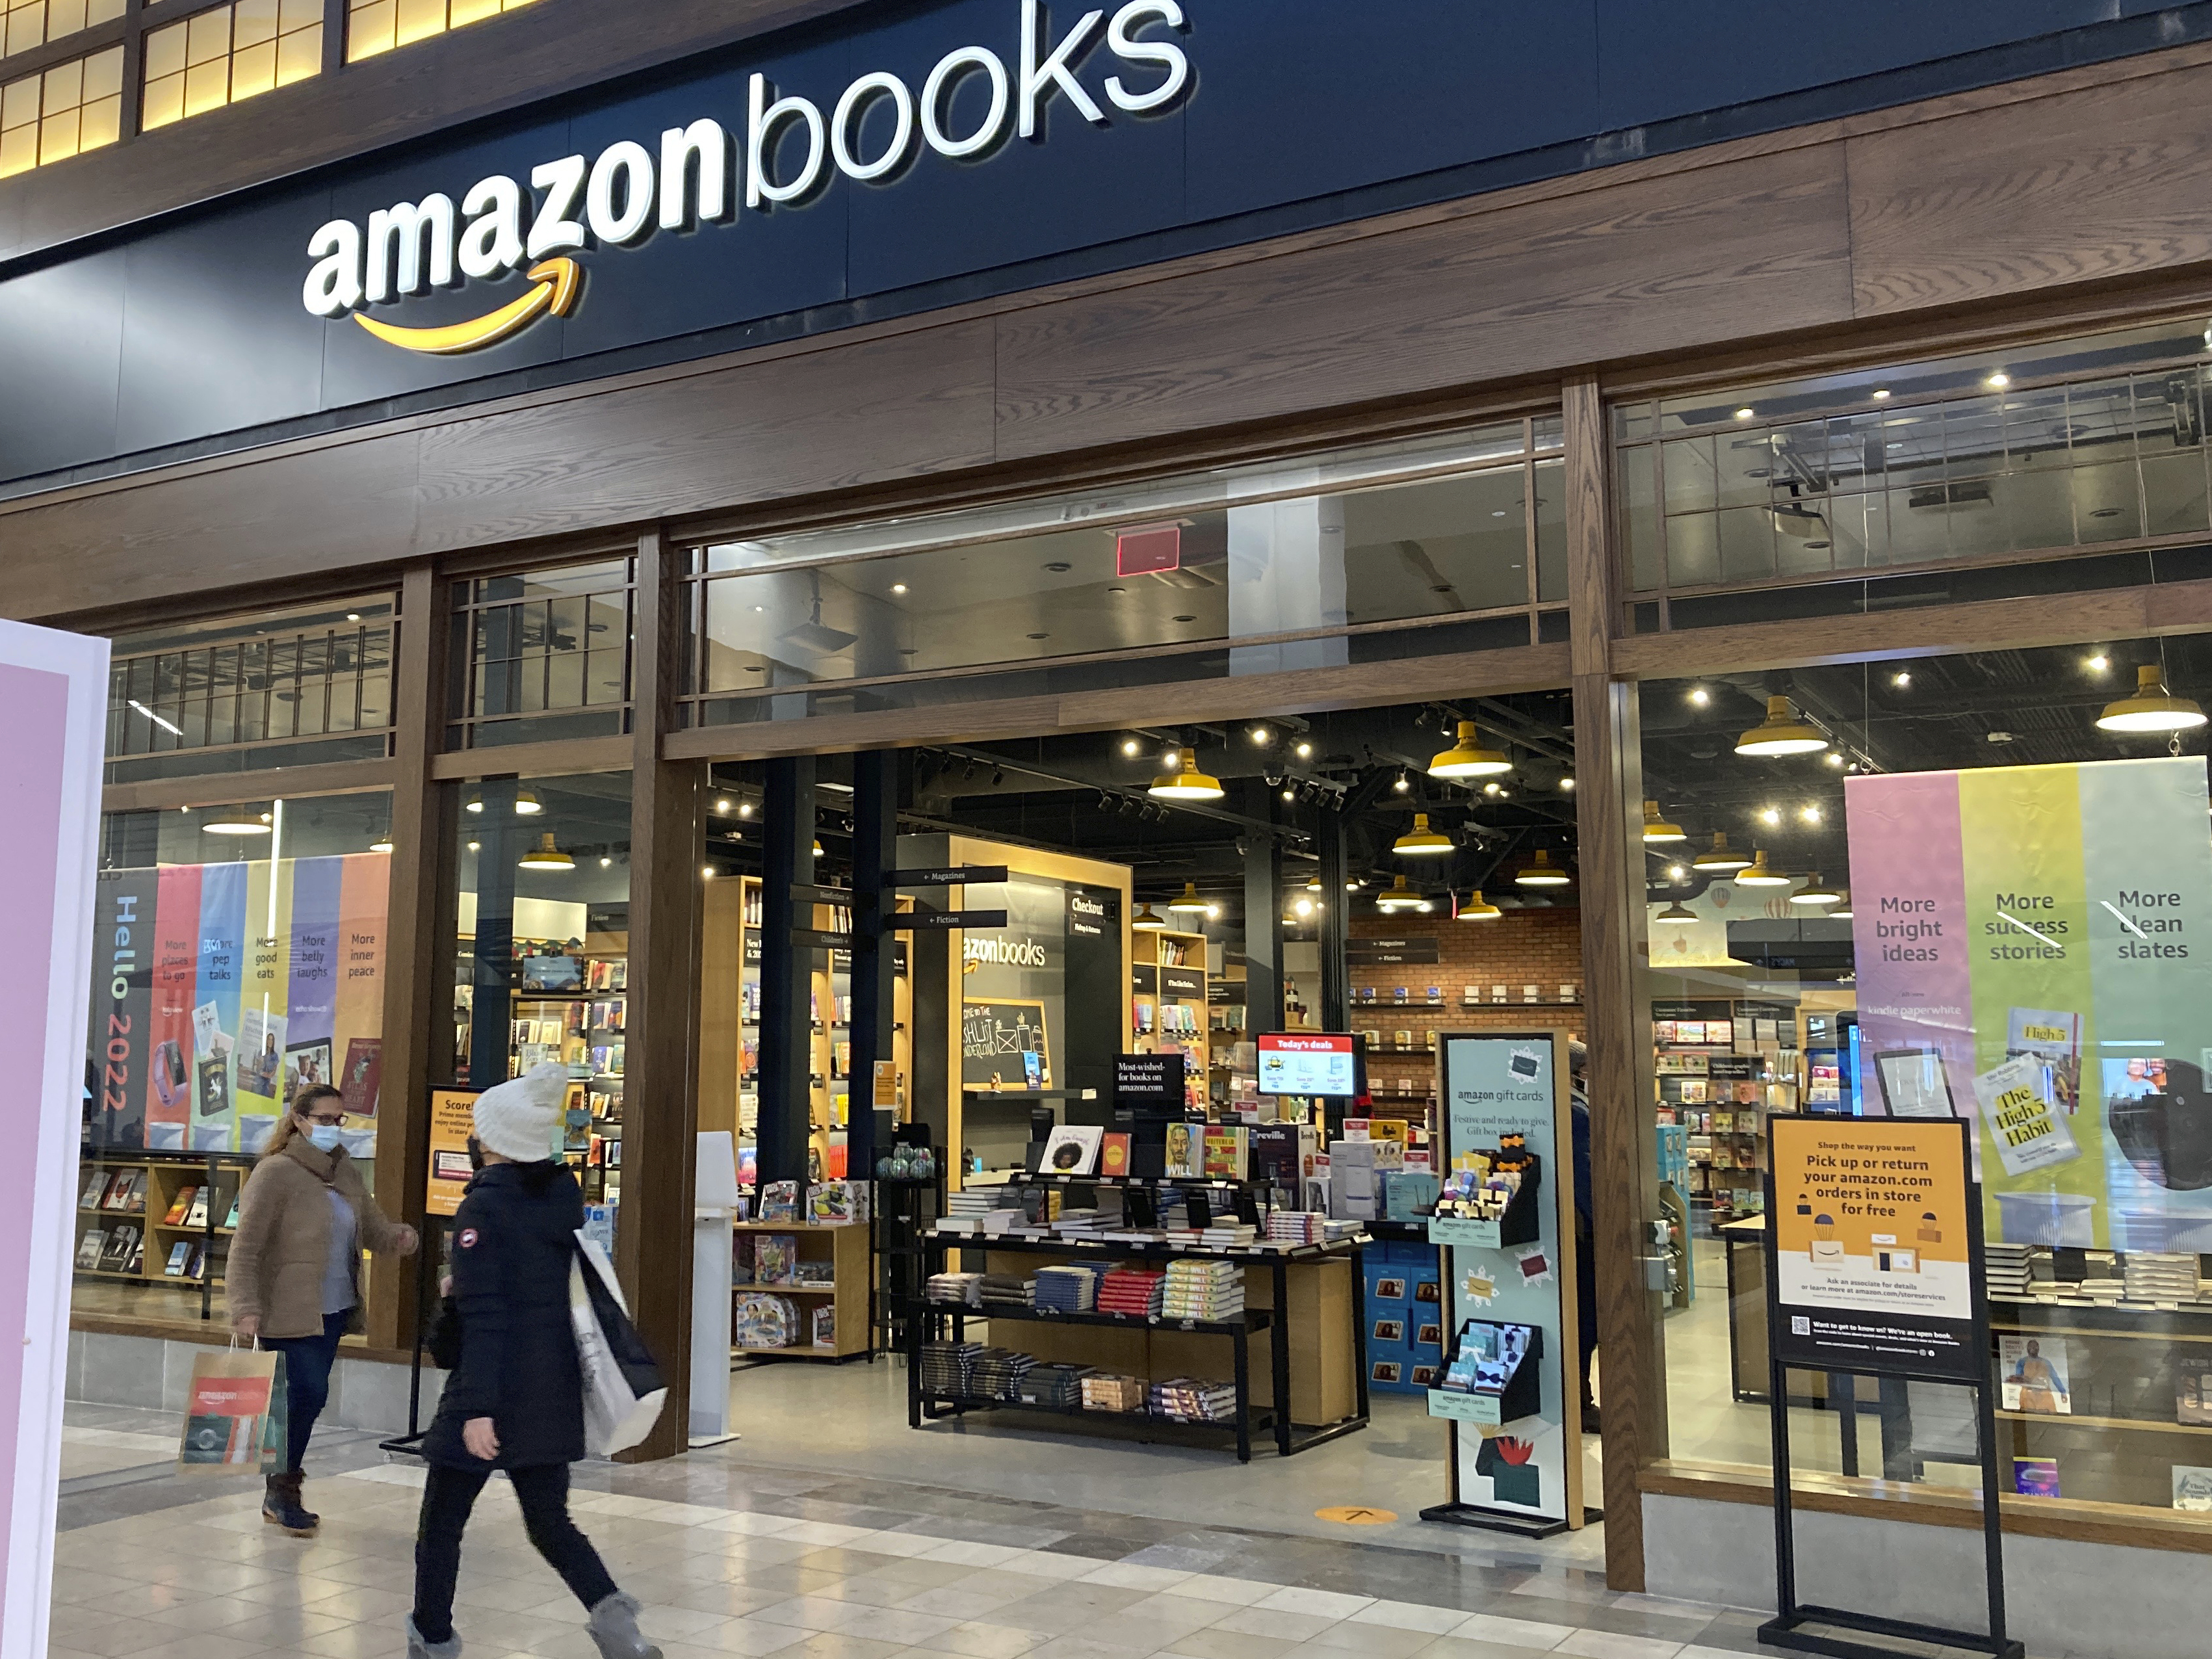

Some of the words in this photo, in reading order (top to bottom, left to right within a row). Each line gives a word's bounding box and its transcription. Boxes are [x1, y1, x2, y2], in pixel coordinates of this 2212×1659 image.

[931, 872, 965, 881] Magazines
[1880, 896, 1936, 913] More
[1996, 893, 2055, 910] More
[2119, 890, 2181, 908] More
[1072, 897, 1104, 915] Checkout
[1876, 919, 1944, 941] bright
[1985, 920, 2068, 935] success
[2120, 915, 2183, 933] clean
[165, 940, 187, 950] More
[302, 935, 325, 946] More
[352, 934, 375, 944] More
[111, 896, 137, 1000] Hello
[1882, 945, 1939, 962] ideas
[1990, 941, 2066, 960] stories
[2118, 941, 2189, 959] slates
[213, 954, 230, 965] pep
[255, 952, 278, 966] good
[301, 950, 324, 964] belly
[350, 949, 375, 961] inner
[163, 970, 172, 980] to
[174, 971, 185, 982] go
[209, 969, 231, 980] talks
[257, 969, 275, 978] eats
[297, 967, 328, 980] laughs
[348, 967, 375, 980] peace
[1867, 1006, 1899, 1015] kindle
[1900, 1006, 1962, 1017] paperwhite
[2025, 1026, 2053, 1041] High
[2056, 1030, 2066, 1041] 5
[1277, 1040, 1308, 1050] Today's
[1310, 1040, 1333, 1049] deals
[103, 1013, 131, 1112] 2022
[1118, 1062, 1165, 1071] Most-wished-
[1118, 1073, 1128, 1081] for
[1129, 1073, 1151, 1081] books
[1458, 1090, 1494, 1100] amazon
[1496, 1090, 1515, 1103] gift
[1516, 1091, 1544, 1101] cards
[1997, 1087, 2031, 1108] The
[1996, 1103, 2033, 1130] High
[2033, 1097, 2047, 1114] 5
[1453, 1114, 1479, 1124] Festive
[1481, 1116, 1496, 1124] and
[1498, 1116, 1518, 1127] ready
[1467, 1126, 1482, 1135] Gift
[1483, 1127, 1498, 1136] box
[2006, 1119, 2052, 1147] Habit
[1817, 1142, 1840, 1151] Shop
[1806, 1155, 1837, 1167] Pick
[1841, 1158, 1858, 1170] up
[1862, 1160, 1879, 1169] or
[1882, 1160, 1929, 1171] return
[1167, 1164, 1192, 1177] WILL
[1804, 1173, 1836, 1184] your
[1840, 1173, 1932, 1186] amazon.com
[1816, 1186, 1862, 1199] orders
[1866, 1188, 1879, 1200] in
[1882, 1190, 1921, 1202] store
[1841, 1203, 1863, 1215] for
[1866, 1203, 1896, 1216] free
[1850, 1279, 1881, 1288] associate
[1854, 1288, 1946, 1301] amazon.com/storeservices
[1813, 1320, 1829, 1329] Want
[1838, 1323, 1849, 1331] get
[1858, 1324, 1875, 1332] know
[1916, 1331, 1933, 1339] open
